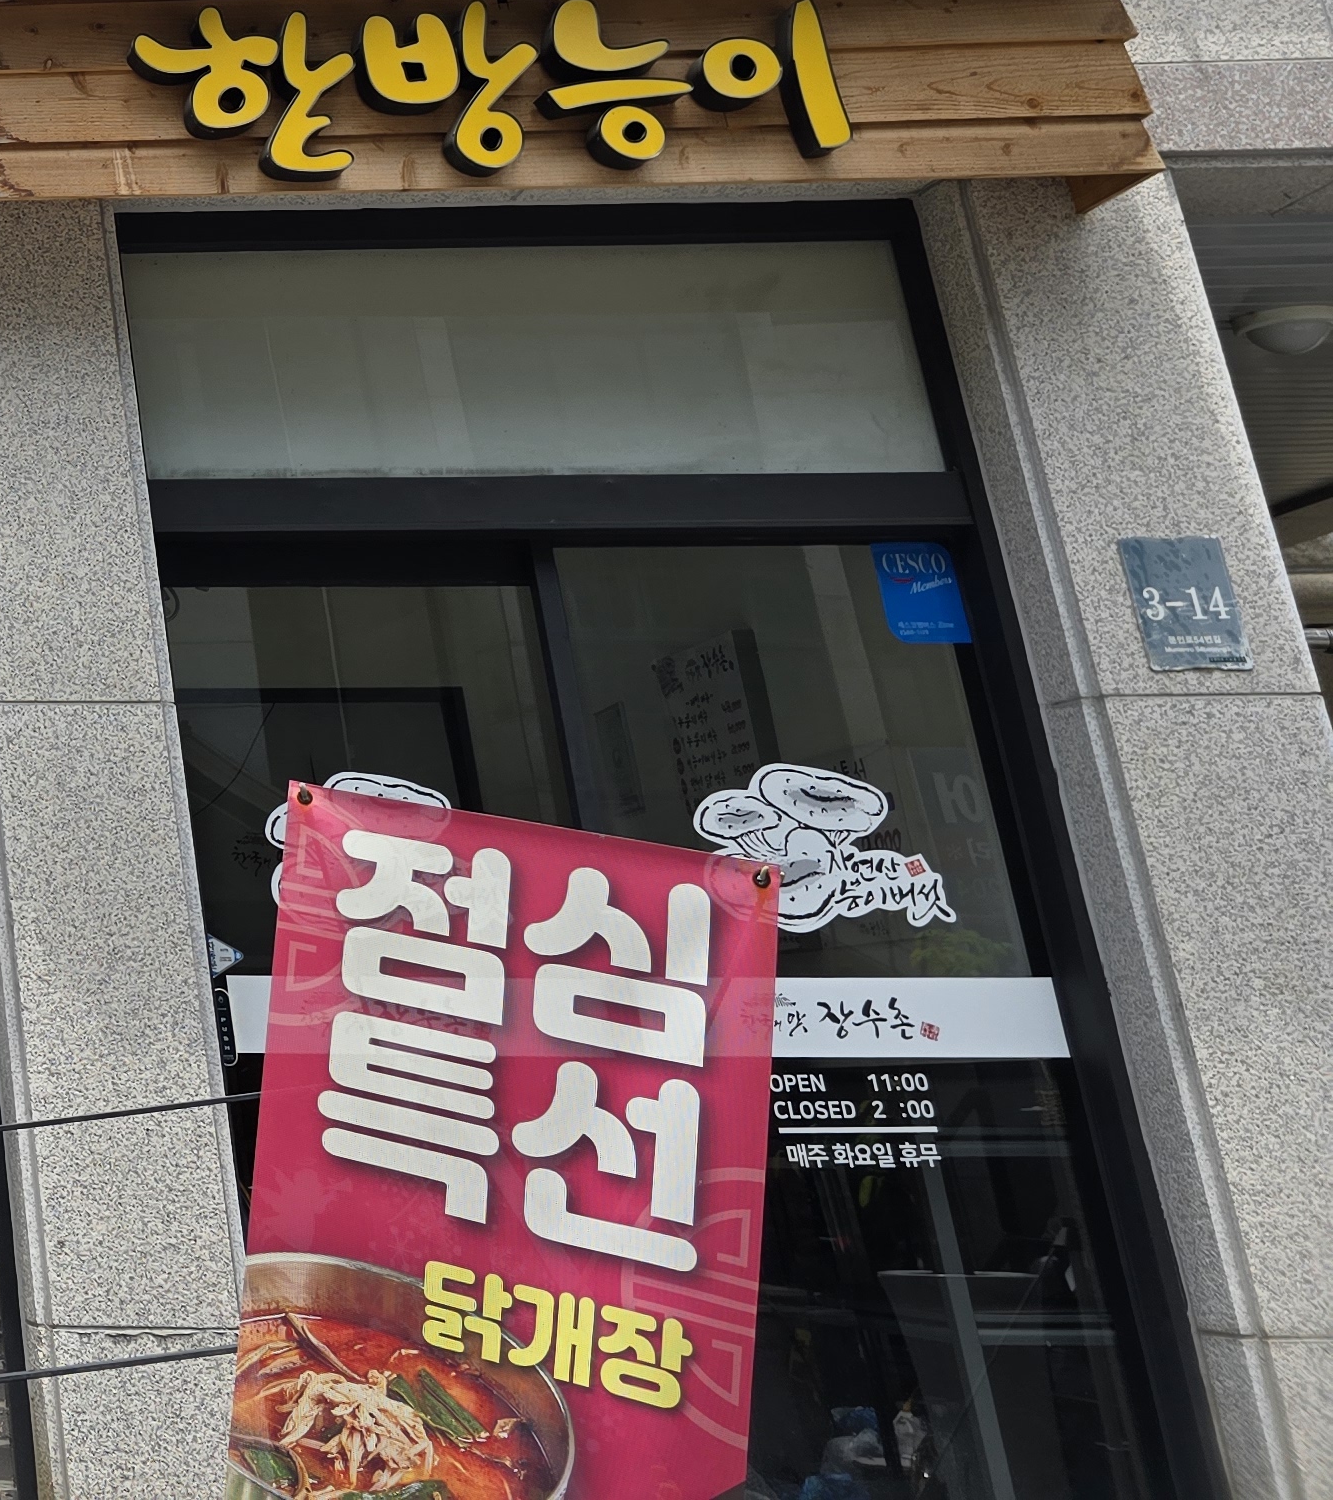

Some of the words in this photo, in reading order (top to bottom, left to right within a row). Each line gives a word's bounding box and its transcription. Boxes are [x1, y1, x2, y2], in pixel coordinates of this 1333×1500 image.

[883, 552, 946, 574] CESCO
[910, 574, 952, 594] Members
[1142, 586, 1231, 621] 3-14
[828, 850, 901, 880] 자연산
[834, 878, 952, 921] 능이버섯
[335, 829, 711, 1068] 점심
[786, 1011, 809, 1038] 맛
[816, 997, 916, 1040] 장수촌
[770, 1073, 826, 1092] OPEN
[867, 1073, 929, 1092] 11:00
[773, 1100, 857, 1120] CLOSED
[317, 1009, 701, 1272] 특선
[786, 1143, 829, 1168] 매주
[831, 1143, 896, 1168] 화요일
[898, 1142, 942, 1168] 휴무
[423, 1260, 693, 1409] 닭개장
